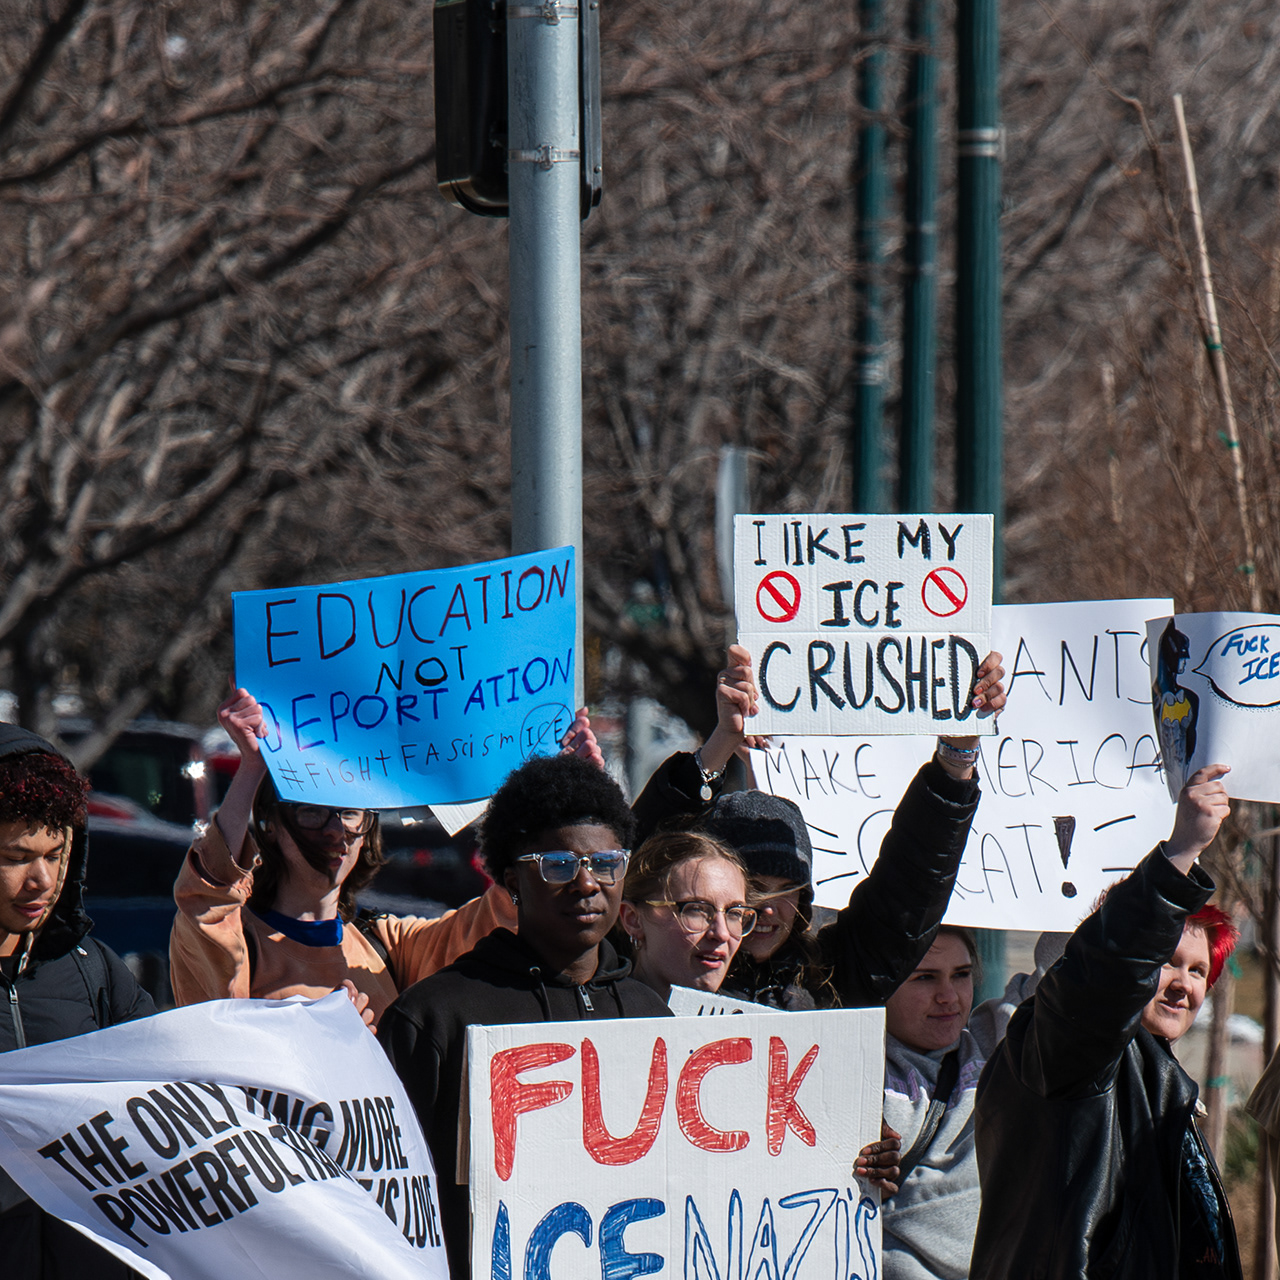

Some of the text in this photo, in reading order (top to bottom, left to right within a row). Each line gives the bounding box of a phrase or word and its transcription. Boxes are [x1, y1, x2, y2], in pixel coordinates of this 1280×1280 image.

[752, 520, 767, 566] I
[896, 518, 964, 562] MY
[266, 560, 569, 668] EDUCATION
[820, 579, 905, 628] ICE
[375, 645, 468, 694] NOT
[758, 634, 980, 721] CRUSHED
[1006, 629, 1153, 706] ANTS
[1220, 633, 1270, 657] FUCK
[258, 648, 572, 753] DEPORTATION
[526, 717, 565, 748] ICE
[765, 733, 1166, 800] MAKE ERICA
[37, 1110, 146, 1193] THE
[126, 1081, 241, 1160] ONLY
[335, 1096, 409, 1173] MORE
[489, 1036, 820, 1182] FUCK
[91, 1130, 305, 1249] POWERFUL
[399, 1174, 442, 1249] LOVE
